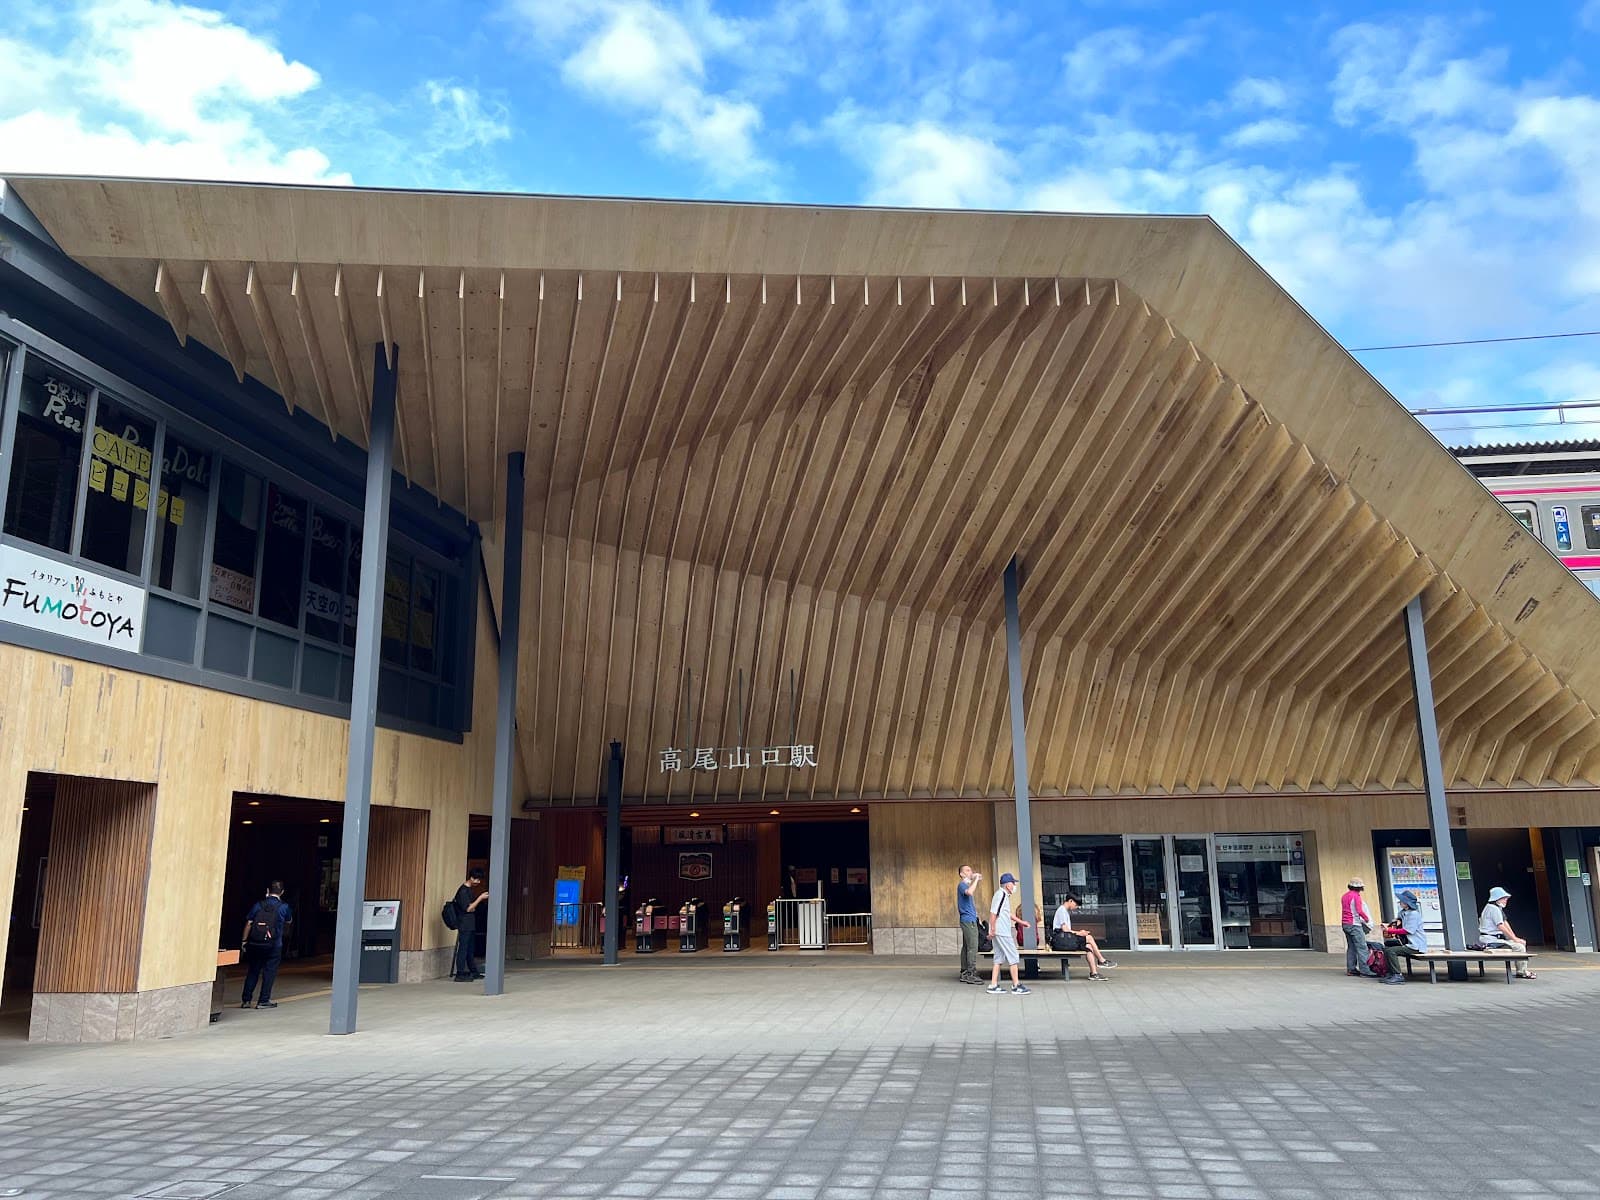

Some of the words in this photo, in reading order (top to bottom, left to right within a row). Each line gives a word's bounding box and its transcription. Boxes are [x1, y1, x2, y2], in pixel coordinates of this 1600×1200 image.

[93, 432, 151, 473] CAFE
[31, 569, 69, 587] イタリアン
[89, 588, 123, 604] ふもとや
[658, 744, 819, 773] 高尾山口駅
